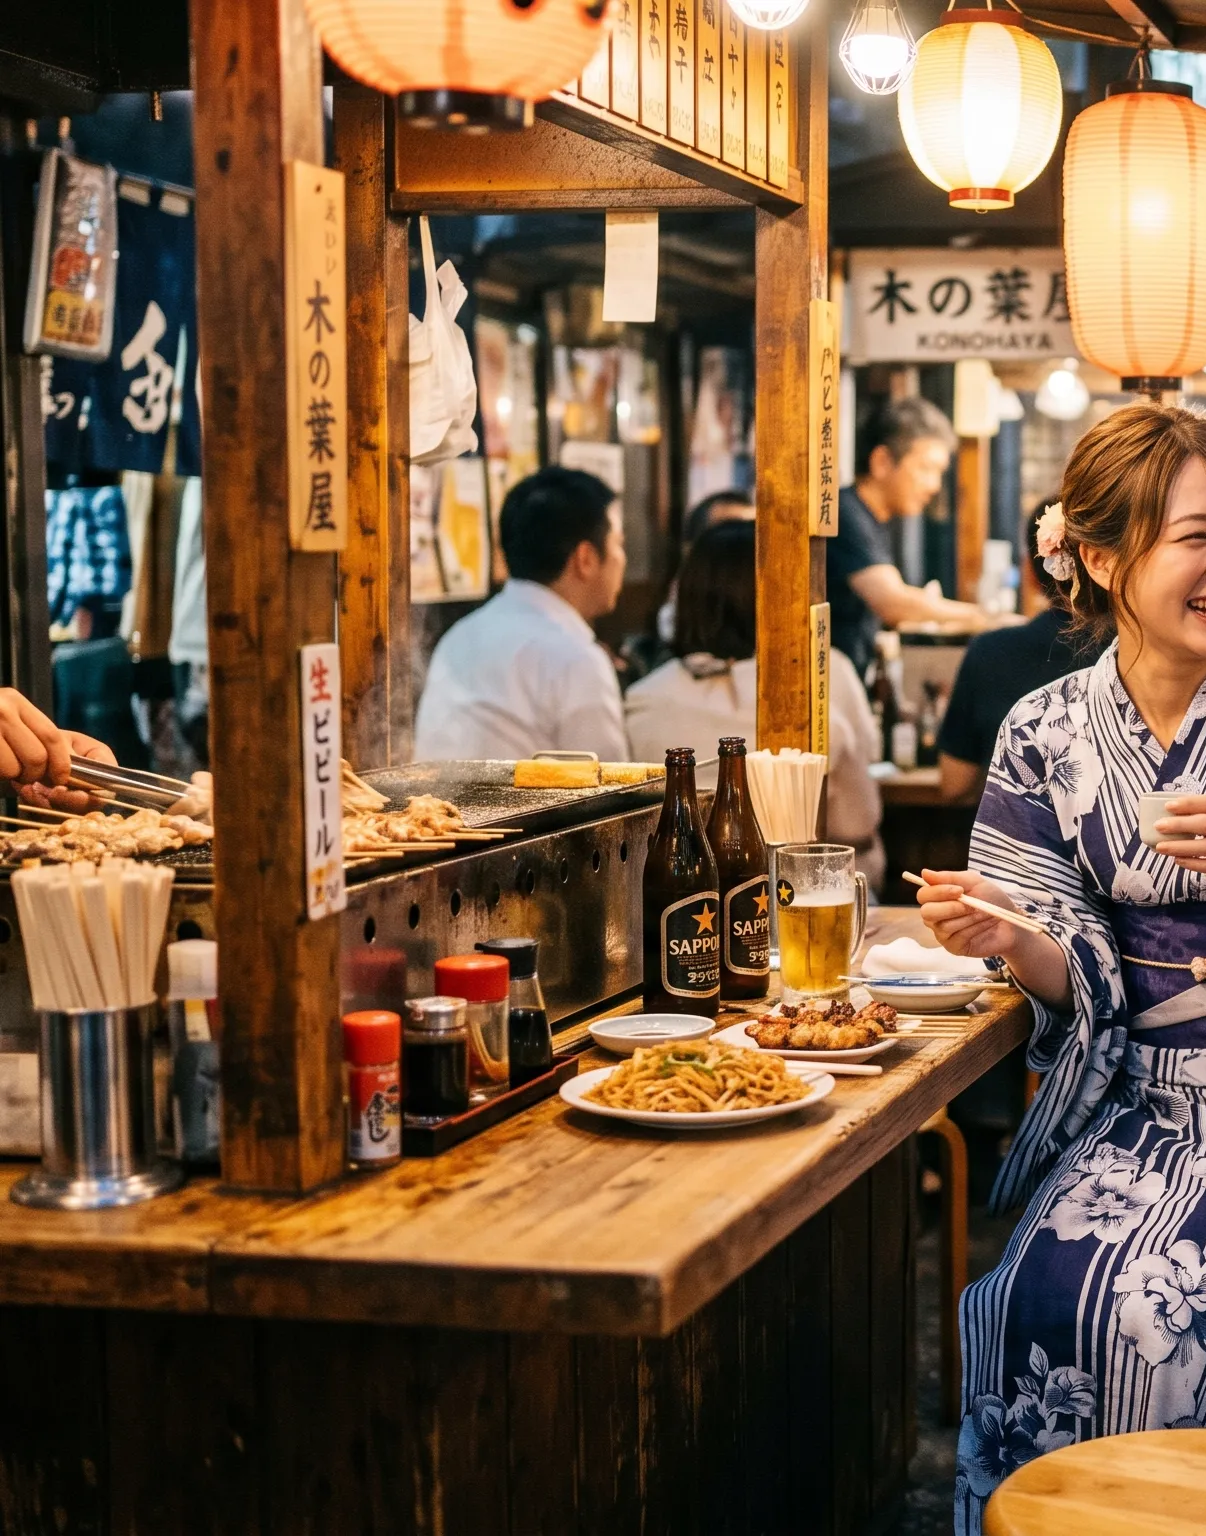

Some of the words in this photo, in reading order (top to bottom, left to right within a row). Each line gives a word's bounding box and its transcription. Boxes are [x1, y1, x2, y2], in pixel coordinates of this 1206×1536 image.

[916, 332, 1053, 351] KONOHAYA
[303, 278, 337, 532] 木の葉屋
[732, 918, 769, 937] SAPP
[669, 934, 720, 956] SAPPO
